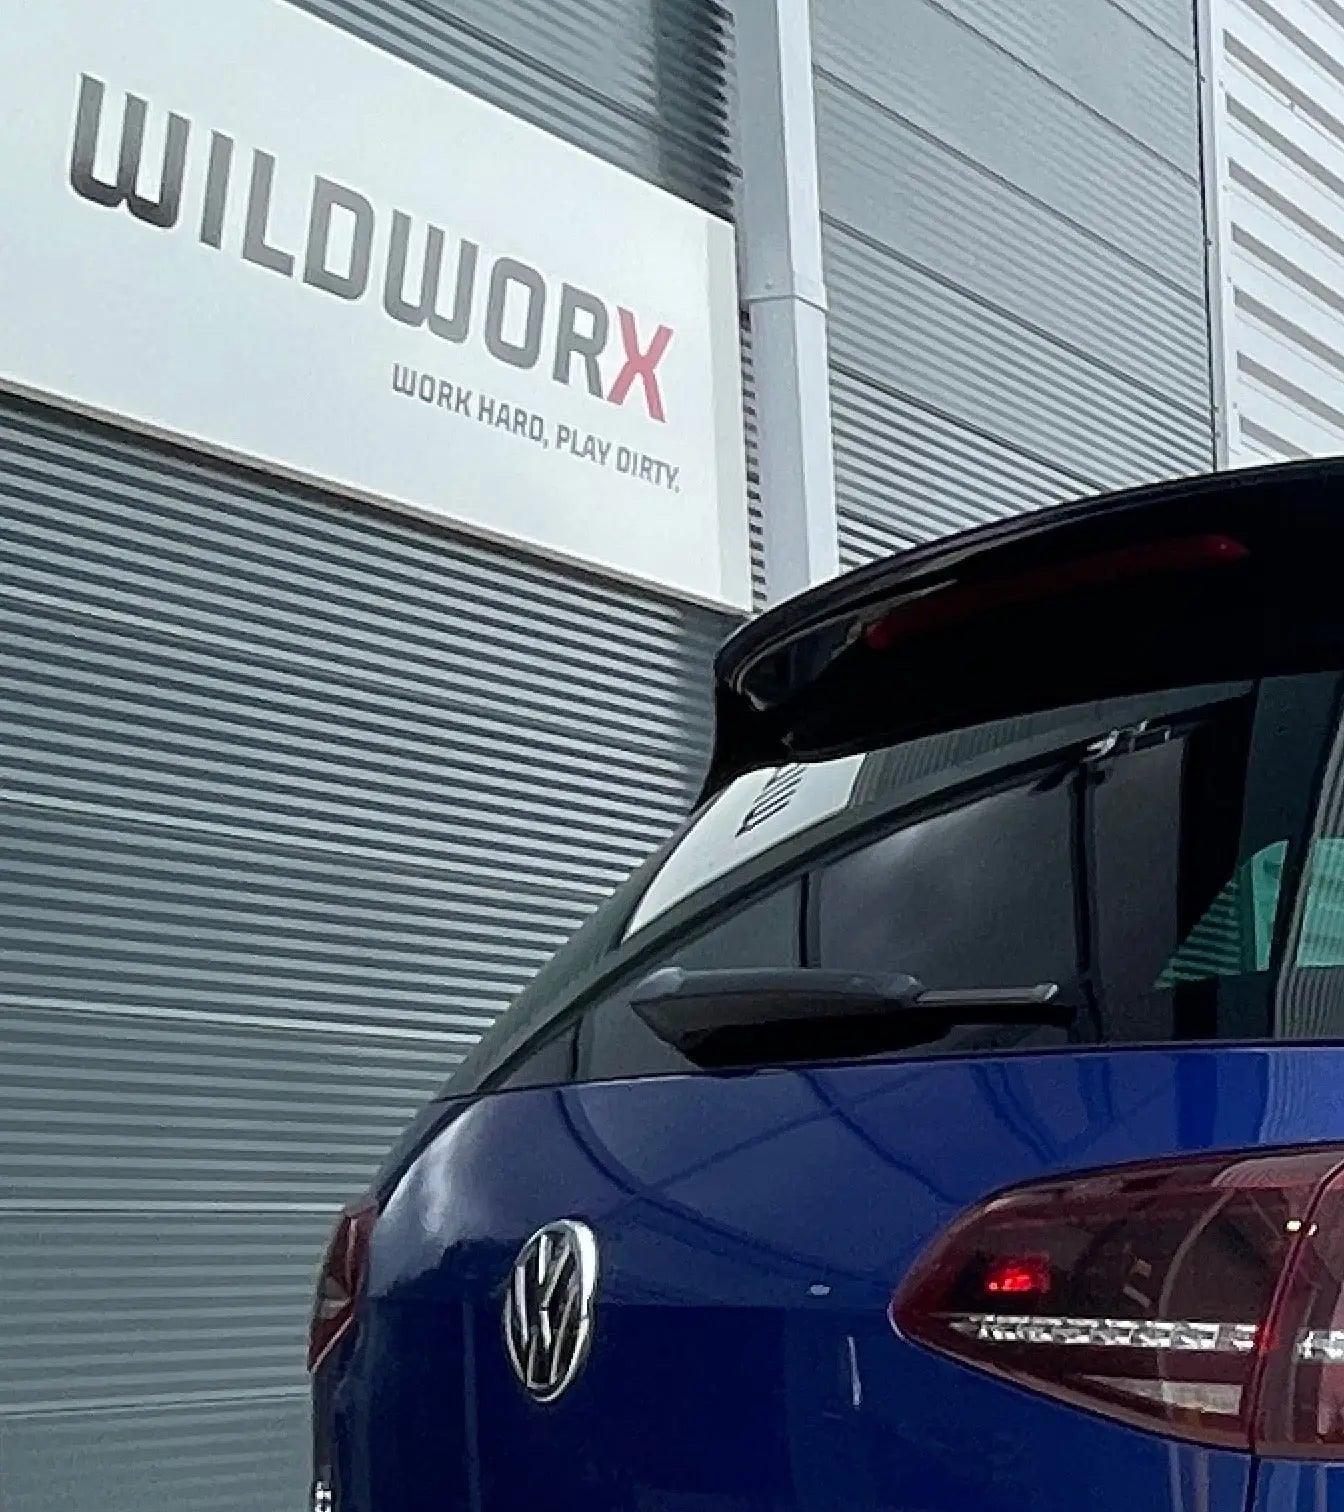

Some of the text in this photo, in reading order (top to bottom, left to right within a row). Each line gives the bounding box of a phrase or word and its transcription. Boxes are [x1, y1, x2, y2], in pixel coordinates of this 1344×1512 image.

[68, 72, 674, 424] WILDWORX
[392, 363, 681, 493] WORK HARD, PLAY DIRTY.
